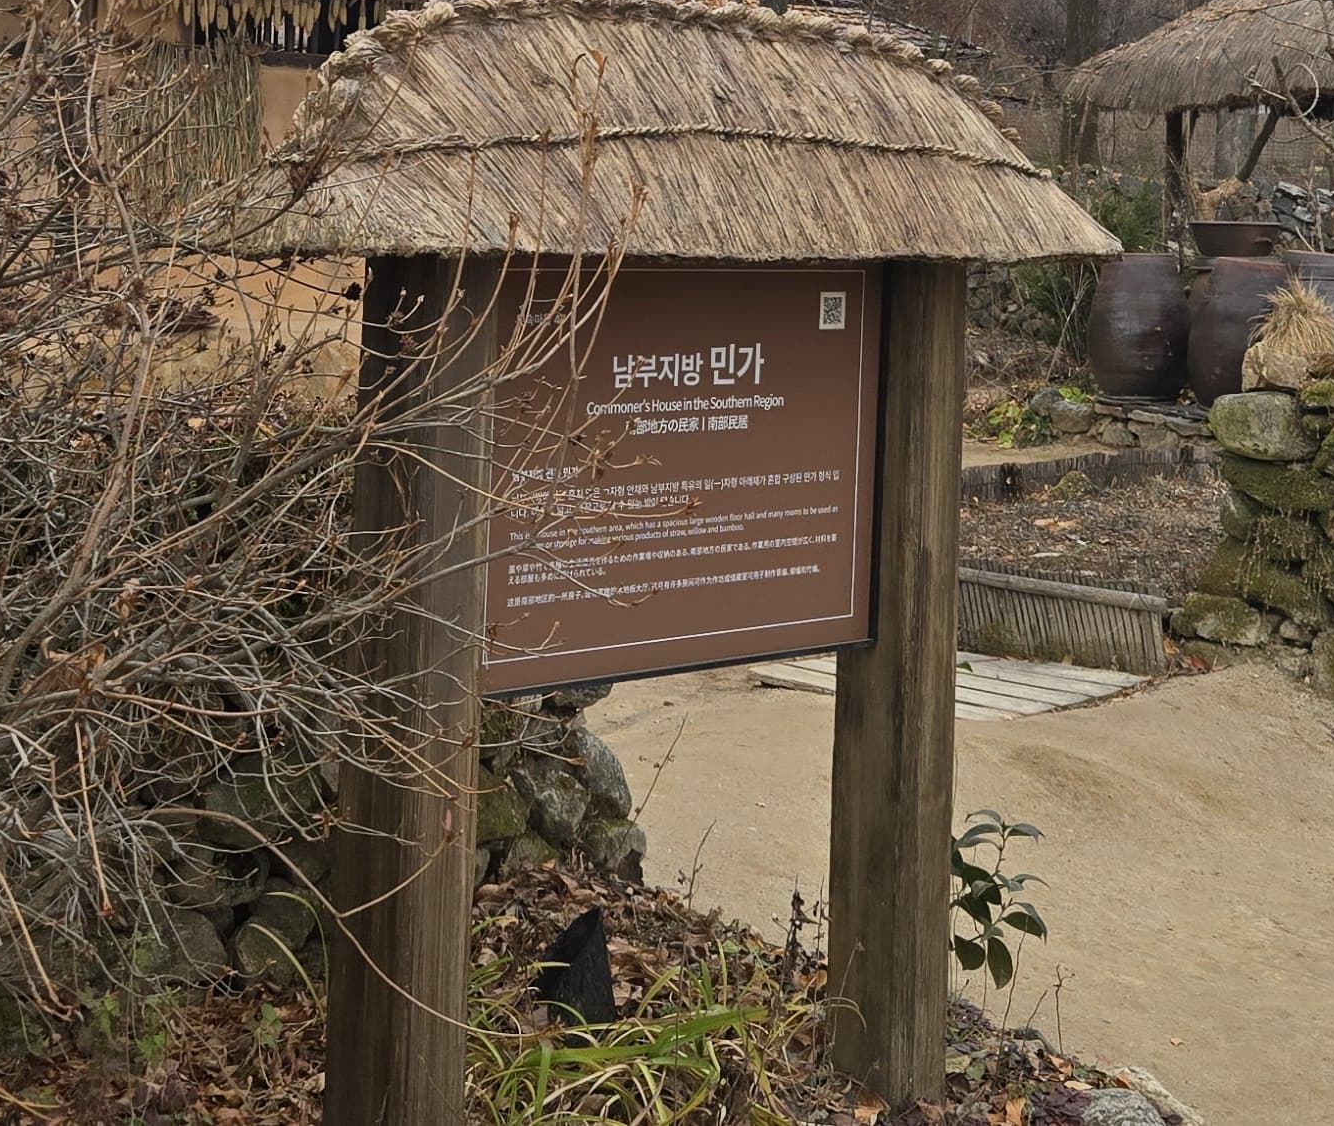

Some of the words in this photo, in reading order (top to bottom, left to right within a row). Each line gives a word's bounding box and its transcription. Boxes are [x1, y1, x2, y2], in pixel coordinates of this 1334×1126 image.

[612, 352, 703, 388] 남부지방
[710, 343, 764, 385] 민가
[586, 399, 651, 415] Commoner's
[652, 398, 682, 413] House
[683, 397, 692, 411] in
[693, 396, 709, 410] the
[710, 394, 753, 410] Southern
[754, 393, 784, 411] Region
[626, 417, 699, 435] 部地方の民家
[650, 480, 679, 494] 남부지방
[625, 521, 643, 531] which
